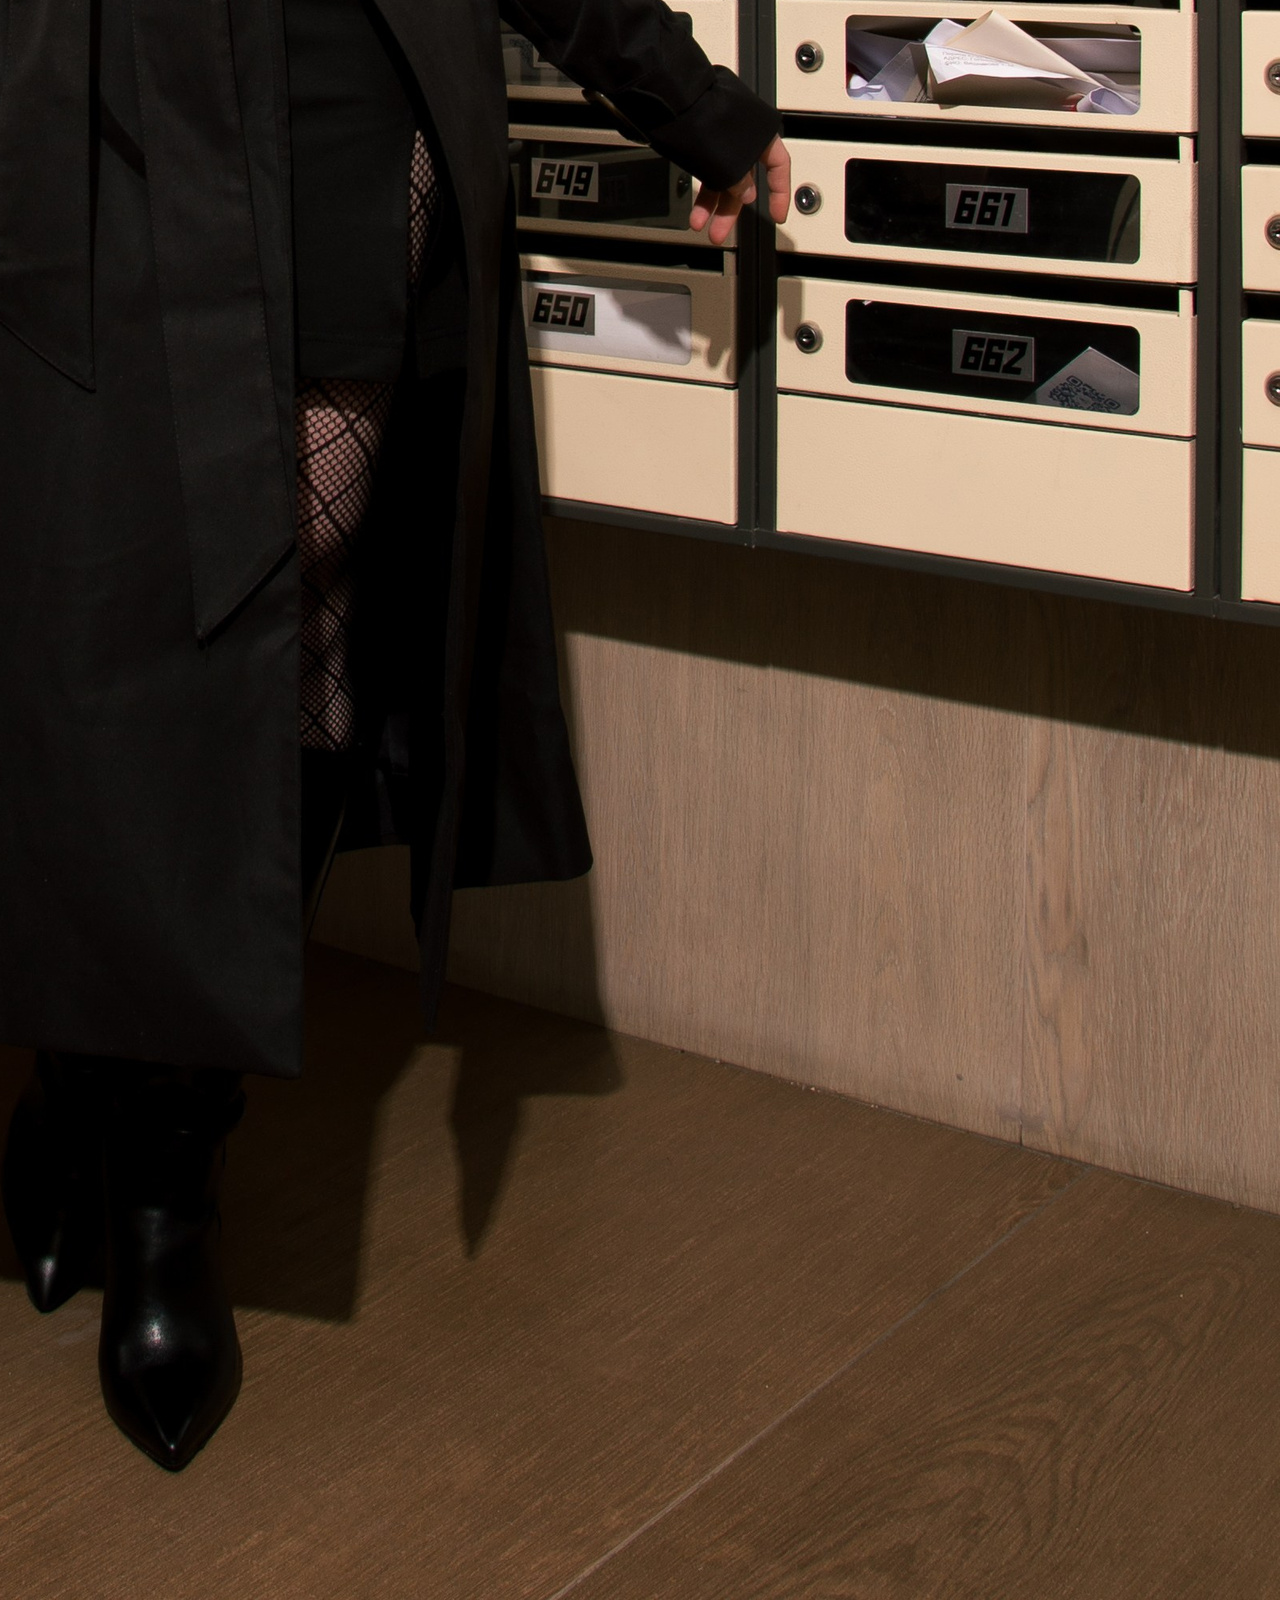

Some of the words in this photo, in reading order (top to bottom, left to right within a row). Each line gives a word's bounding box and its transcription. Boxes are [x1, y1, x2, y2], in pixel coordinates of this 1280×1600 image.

[536, 163, 594, 197] 649
[953, 190, 1016, 227] 661
[532, 292, 589, 328] 650
[960, 336, 1028, 375] 662
